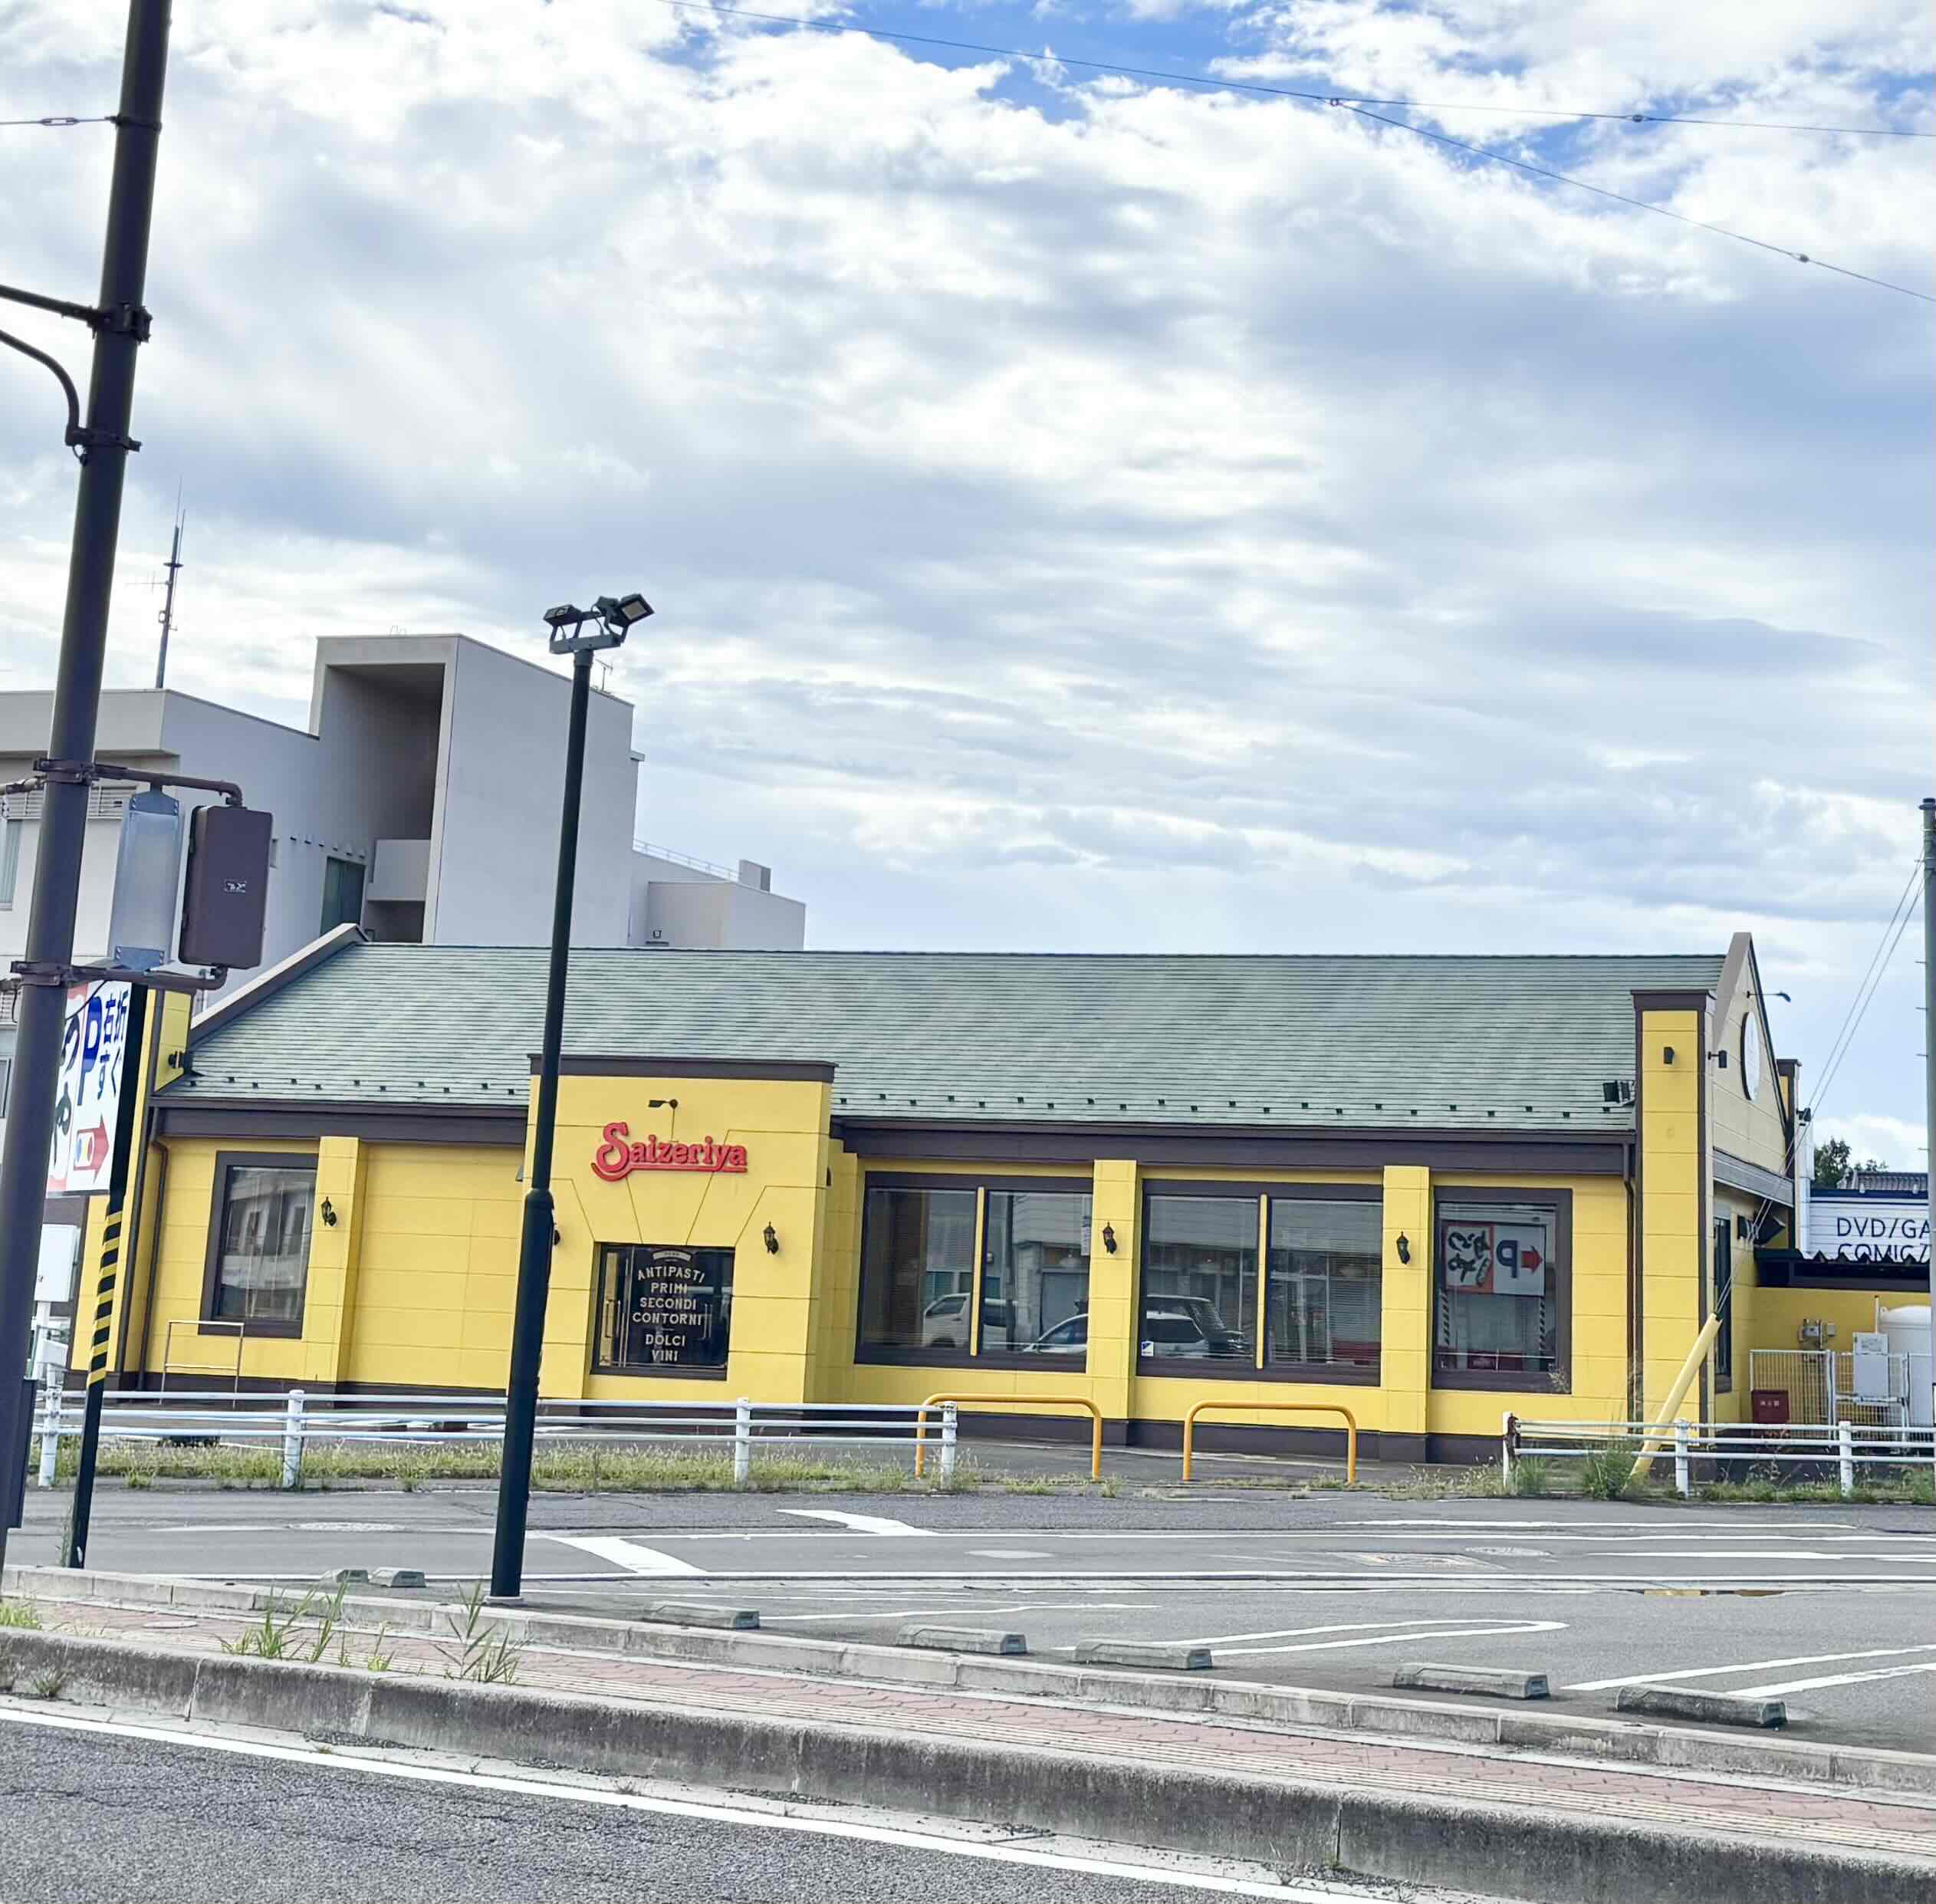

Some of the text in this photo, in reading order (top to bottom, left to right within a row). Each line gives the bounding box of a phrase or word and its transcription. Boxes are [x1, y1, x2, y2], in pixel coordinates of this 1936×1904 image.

[77, 995, 103, 1107] P
[590, 1121, 748, 1182] Saizeriya
[638, 1265, 705, 1283] ANTIPASTI
[650, 1282, 688, 1294] PRIMI
[639, 1297, 697, 1310] SECONDI
[632, 1312, 702, 1326] CONTORNI
[645, 1333, 686, 1347] DOLCI
[652, 1349, 679, 1362] VINI
